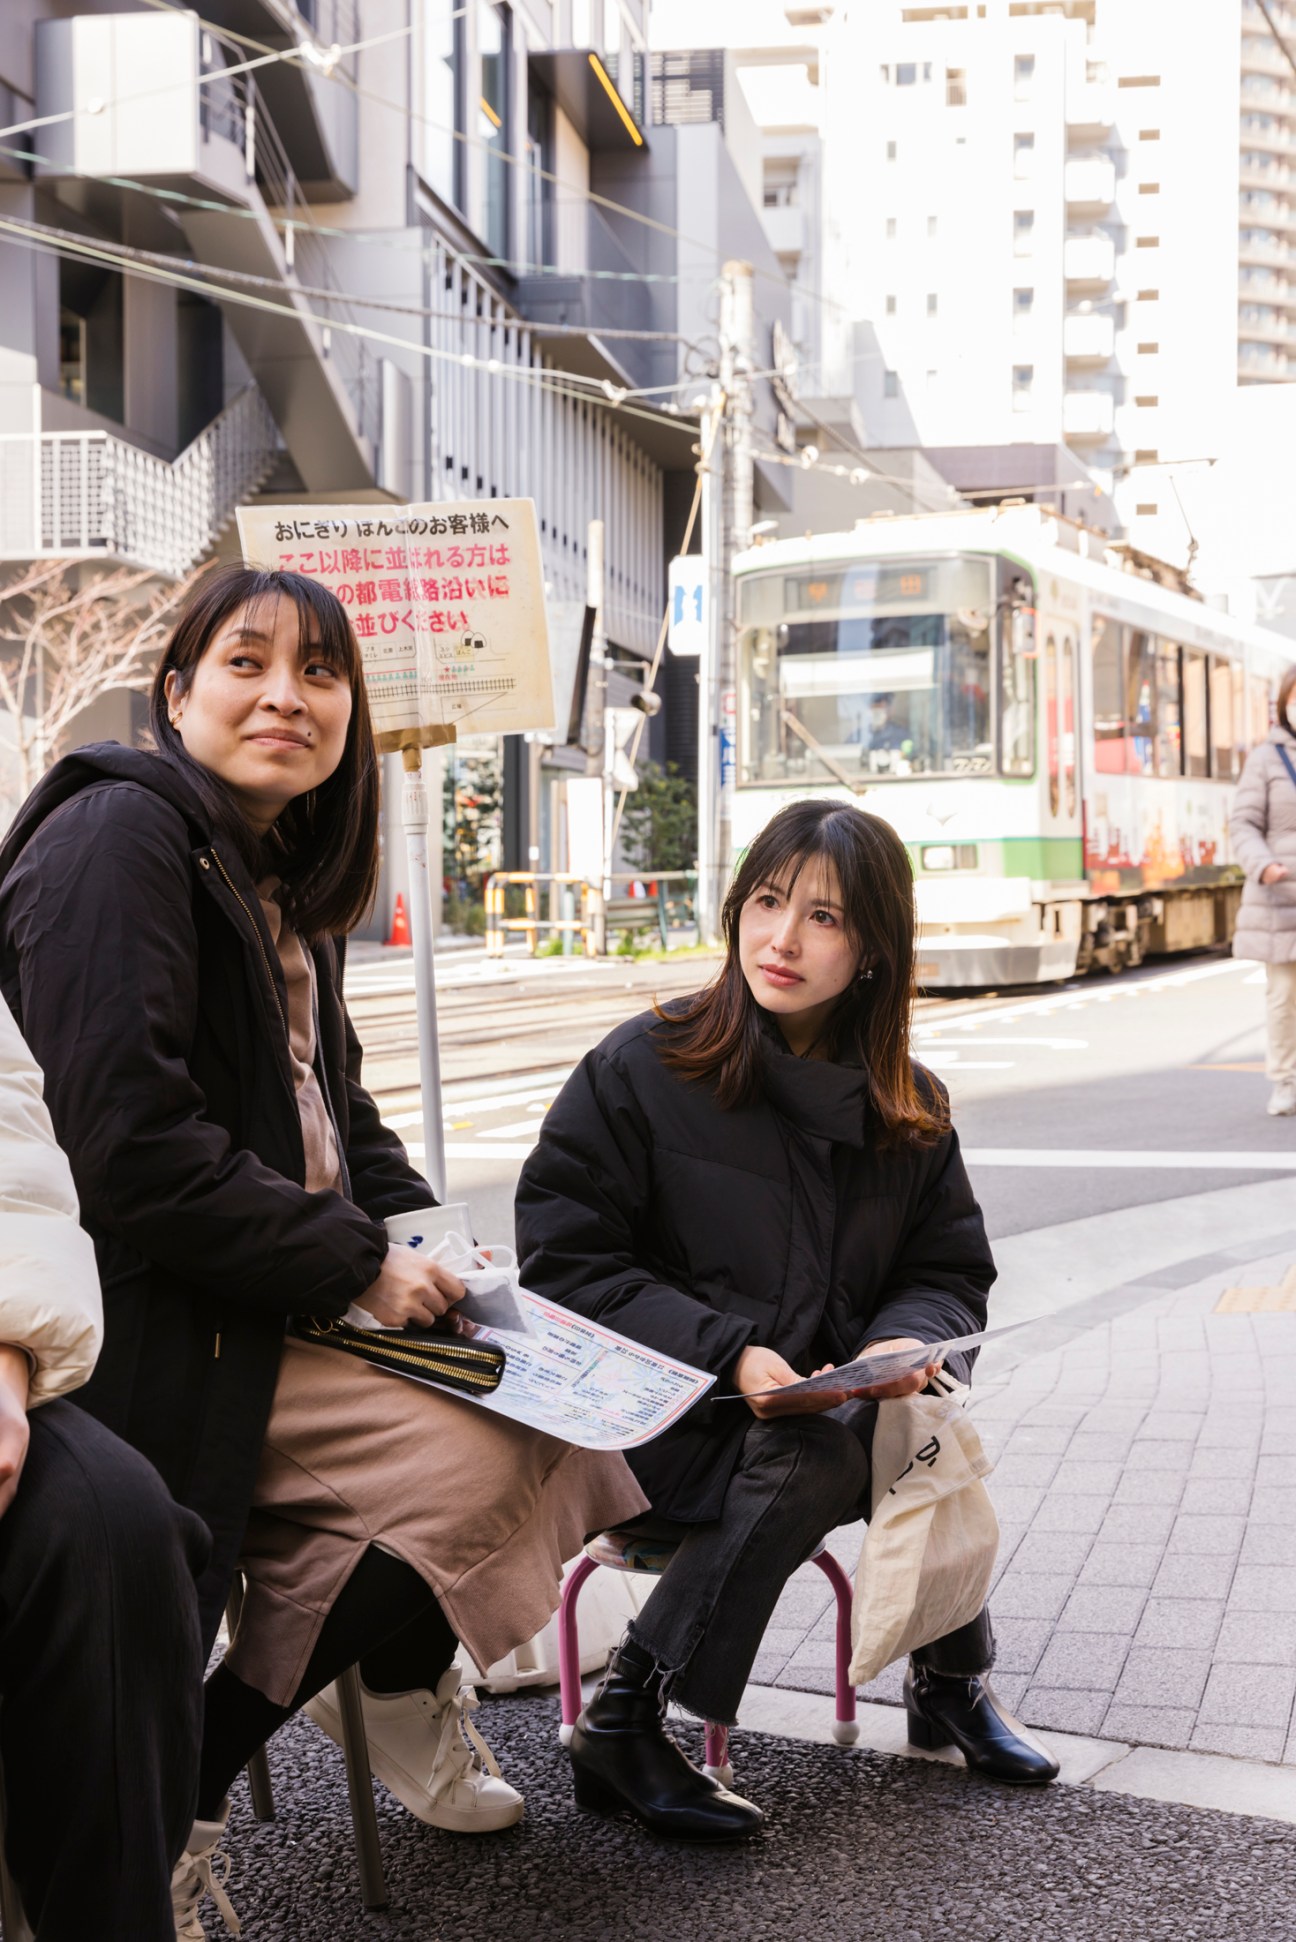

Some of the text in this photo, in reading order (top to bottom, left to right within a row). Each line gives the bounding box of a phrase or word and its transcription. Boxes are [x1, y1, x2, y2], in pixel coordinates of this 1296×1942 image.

[274, 519, 347, 541] おにぎり
[279, 543, 511, 575] ここ以降に並ばれる方は
[349, 609, 468, 637] 並びください
